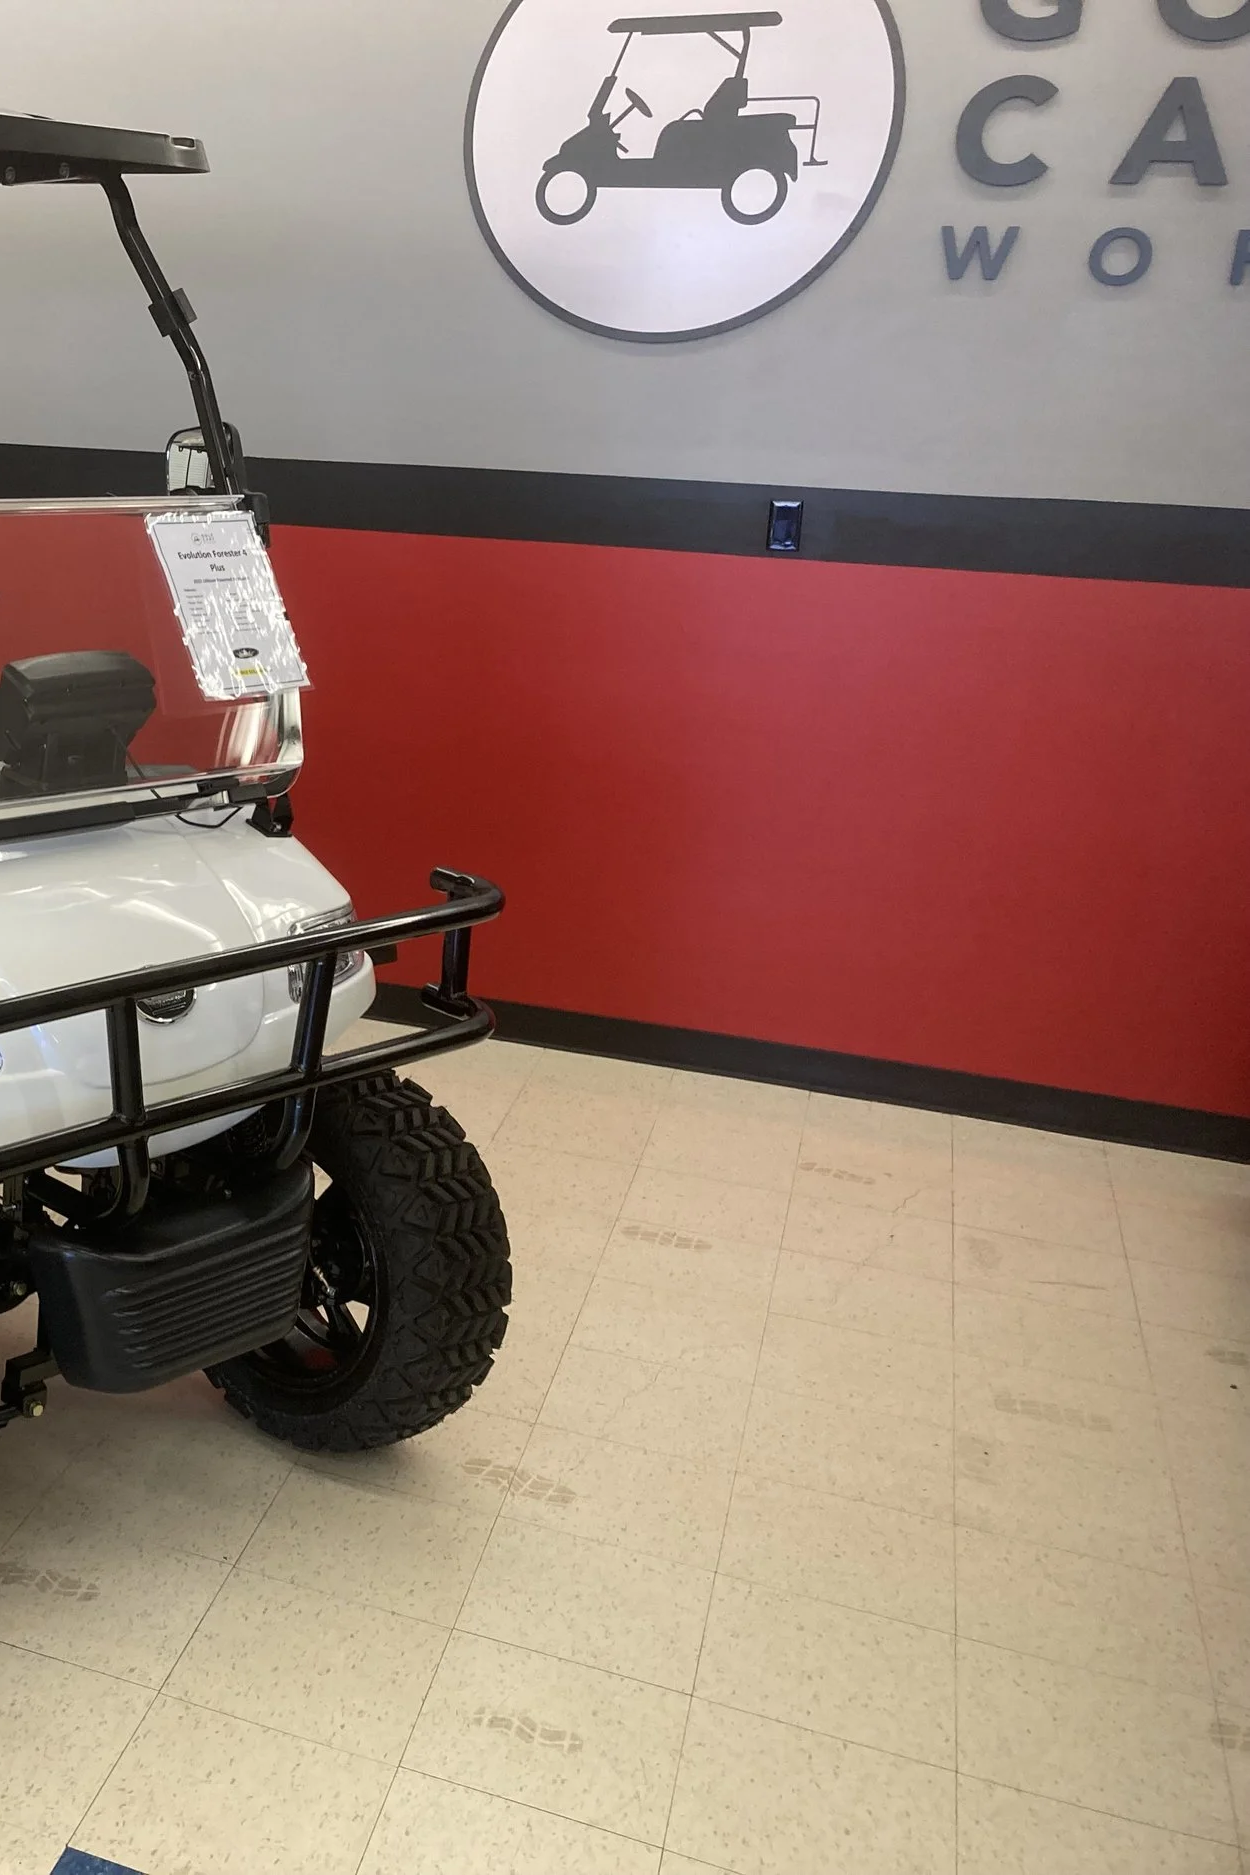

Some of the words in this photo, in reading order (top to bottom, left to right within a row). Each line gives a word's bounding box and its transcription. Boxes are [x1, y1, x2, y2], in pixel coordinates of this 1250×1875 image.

[956, 74, 1229, 187] CA
[177, 550, 212, 561] Evolution
[212, 549, 241, 558] Forester
[209, 563, 226, 572] Plus
